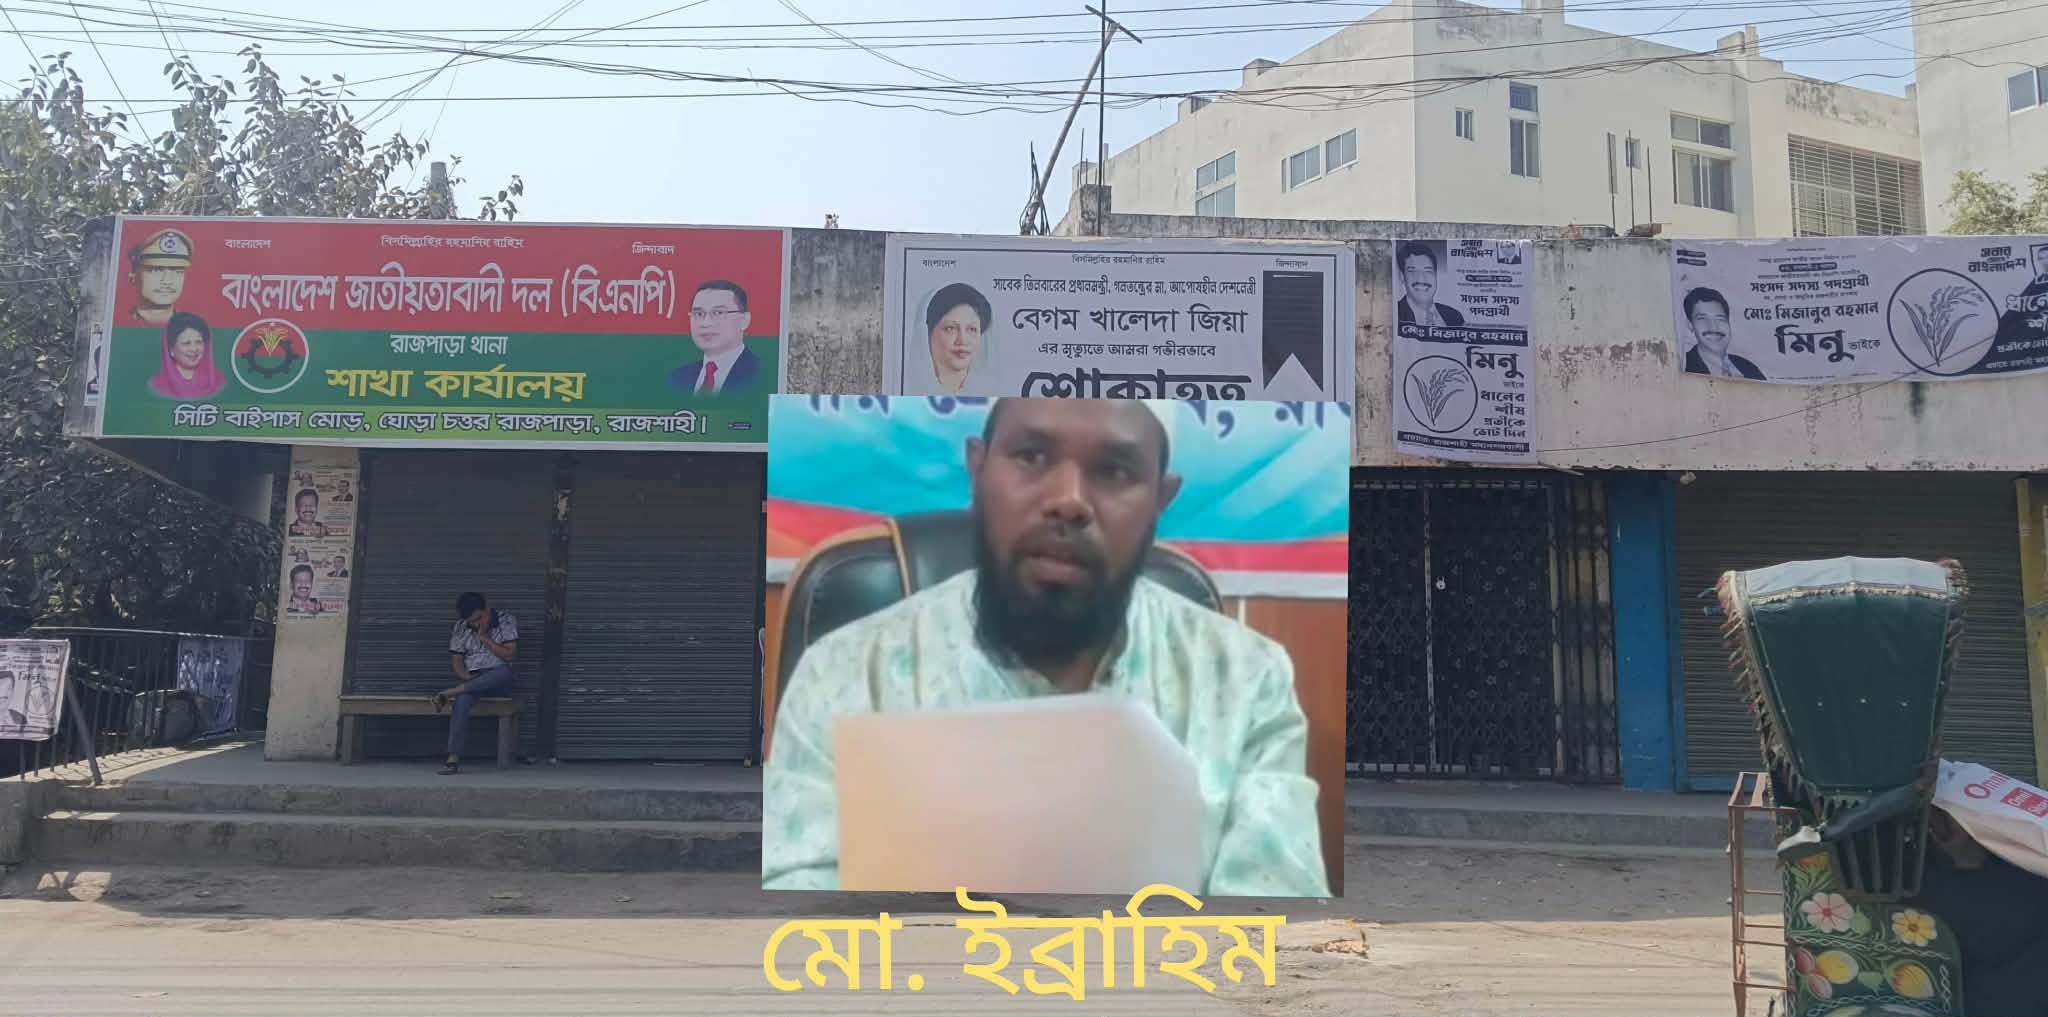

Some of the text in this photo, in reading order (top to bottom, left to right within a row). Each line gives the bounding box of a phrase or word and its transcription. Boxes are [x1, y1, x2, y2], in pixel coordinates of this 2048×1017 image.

[223, 238, 273, 249] বাংলাদেশ
[221, 261, 676, 319] বাংলাদেশ জাতীয়তাবাদী দল (বিএনপি)
[992, 278, 1022, 290] সাবেক
[1023, 273, 1067, 292] তিনবারের
[1749, 282, 1785, 293] সংসদ
[1788, 281, 1820, 292] সদস্য
[1012, 303, 1249, 333] বেগম খালেদা জিয়া
[1743, 302, 1880, 325] মোঃ মিজানুর রহমান
[390, 333, 509, 358] রাজপাড়া থানা
[1038, 340, 1216, 358] এর মৃত্যুতে আমরা গভীরভাবে
[1774, 324, 1855, 363] মিনু
[1465, 345, 1525, 379] মিনু
[325, 363, 588, 403] শাখা কার্যালয়
[1480, 390, 1526, 403] ধানের
[173, 404, 219, 427] সিটি
[224, 407, 303, 430] বাইপাস
[308, 411, 372, 432] মোড়,
[378, 412, 436, 433] ঘোড়া
[496, 414, 601, 435] রাজপাড়া,
[1494, 402, 1526, 416] শীষ
[1472, 427, 1527, 439] ভোট দিন
